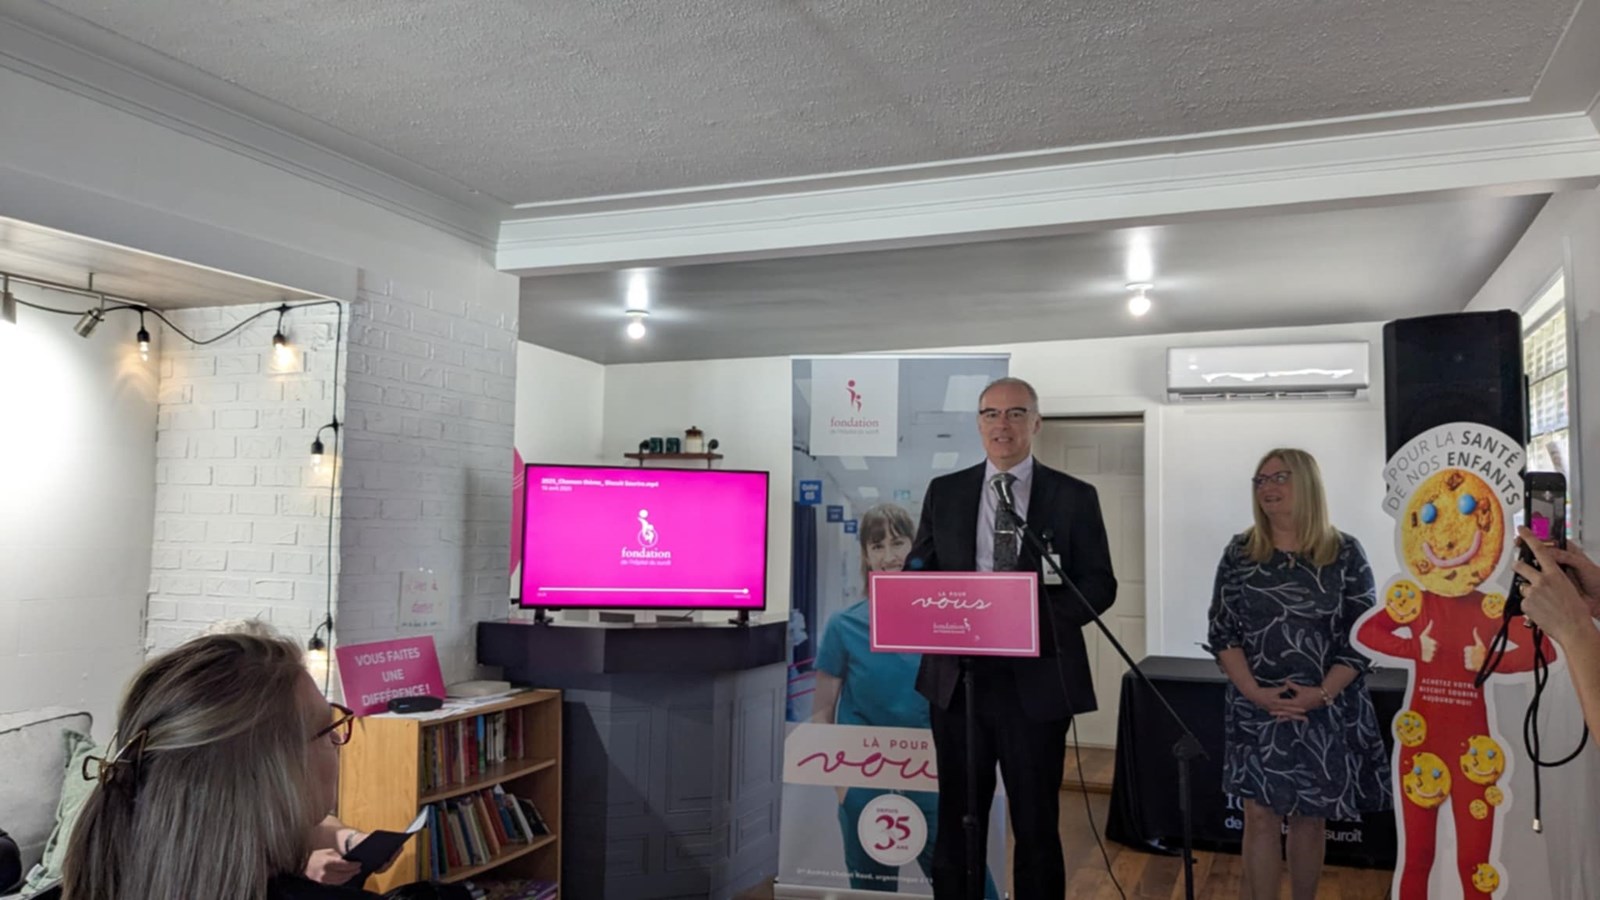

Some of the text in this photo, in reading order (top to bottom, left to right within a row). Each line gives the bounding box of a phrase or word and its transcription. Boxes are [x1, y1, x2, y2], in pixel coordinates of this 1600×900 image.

[830, 416, 879, 428] fondation
[1388, 430, 1521, 482] POUR LA SANTÉ
[1387, 451, 1520, 511] DE NOS ENFANTS
[621, 546, 671, 558] fondation
[911, 597, 992, 610] vous
[355, 647, 421, 666] VOUS FAITES
[382, 669, 405, 682] UNE
[1421, 678, 1451, 688] ACHETEZ
[1419, 686, 1446, 695] BISCUIT
[863, 737, 929, 750] LÀ POUR
[797, 751, 938, 779] vou
[1225, 816, 1242, 829] de
[874, 814, 911, 850] 35
